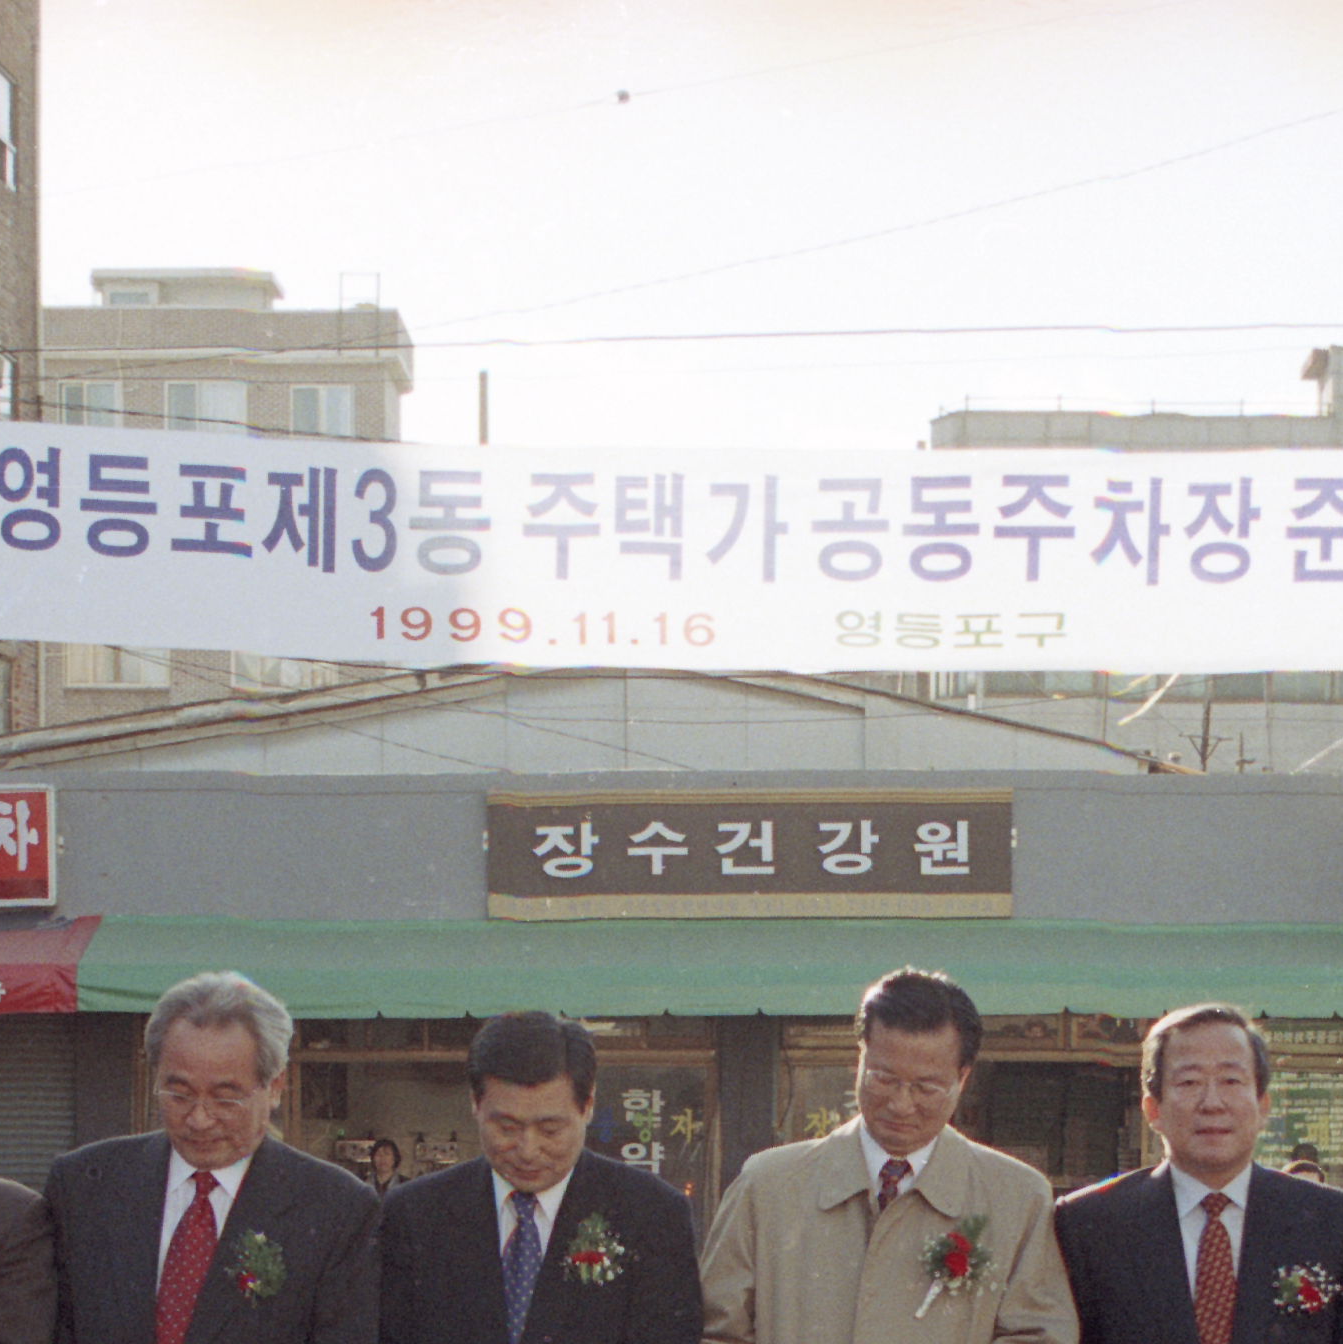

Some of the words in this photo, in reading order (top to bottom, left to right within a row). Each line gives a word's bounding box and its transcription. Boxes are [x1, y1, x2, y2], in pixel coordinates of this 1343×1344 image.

[368, 606, 716, 646] 1999.11.16
[835, 610, 1068, 649] 영등포구
[533, 820, 972, 878] 장수건강원
